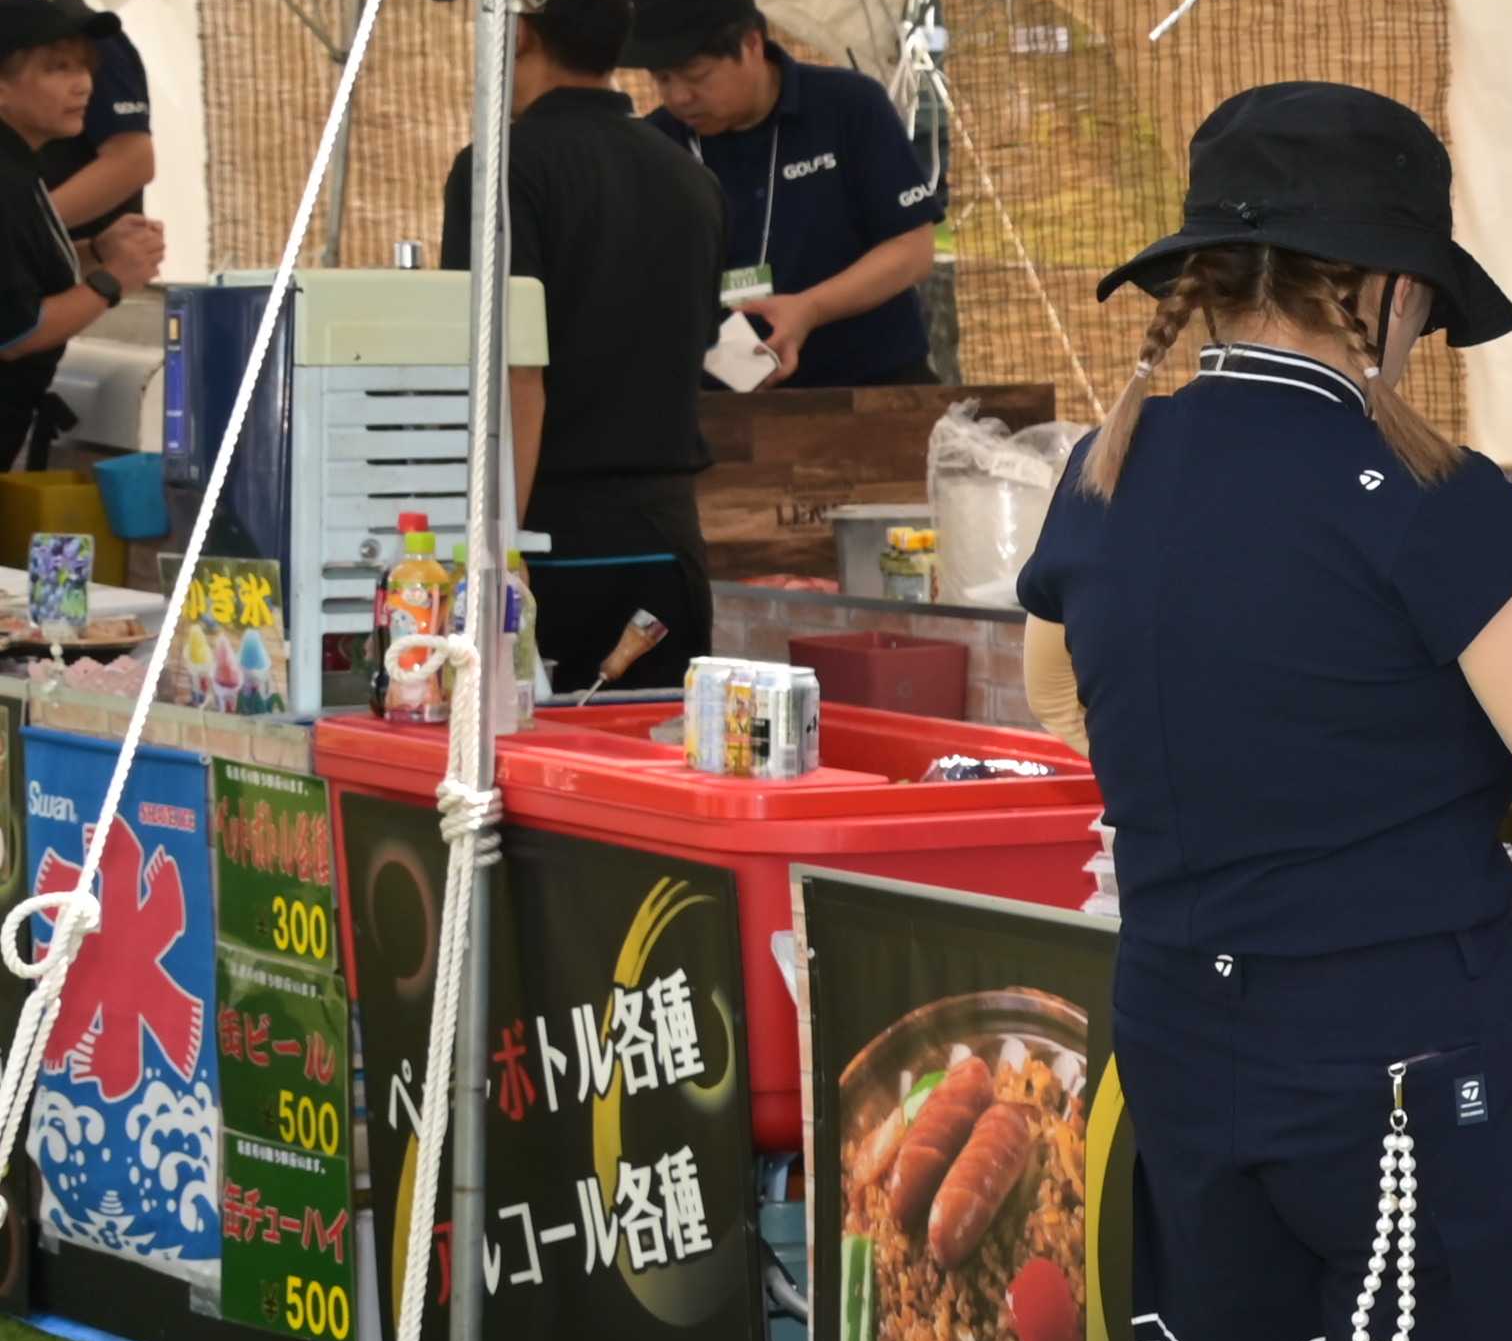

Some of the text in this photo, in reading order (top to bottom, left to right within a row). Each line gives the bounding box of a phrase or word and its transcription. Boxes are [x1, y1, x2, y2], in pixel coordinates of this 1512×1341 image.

[783, 153, 837, 180] GOLF5
[28, 780, 77, 822] Swan
[217, 1006, 337, 1086] 缶ビール
[388, 968, 705, 1140] ペボトル各種
[222, 1178, 350, 1265] 缶チューハイ
